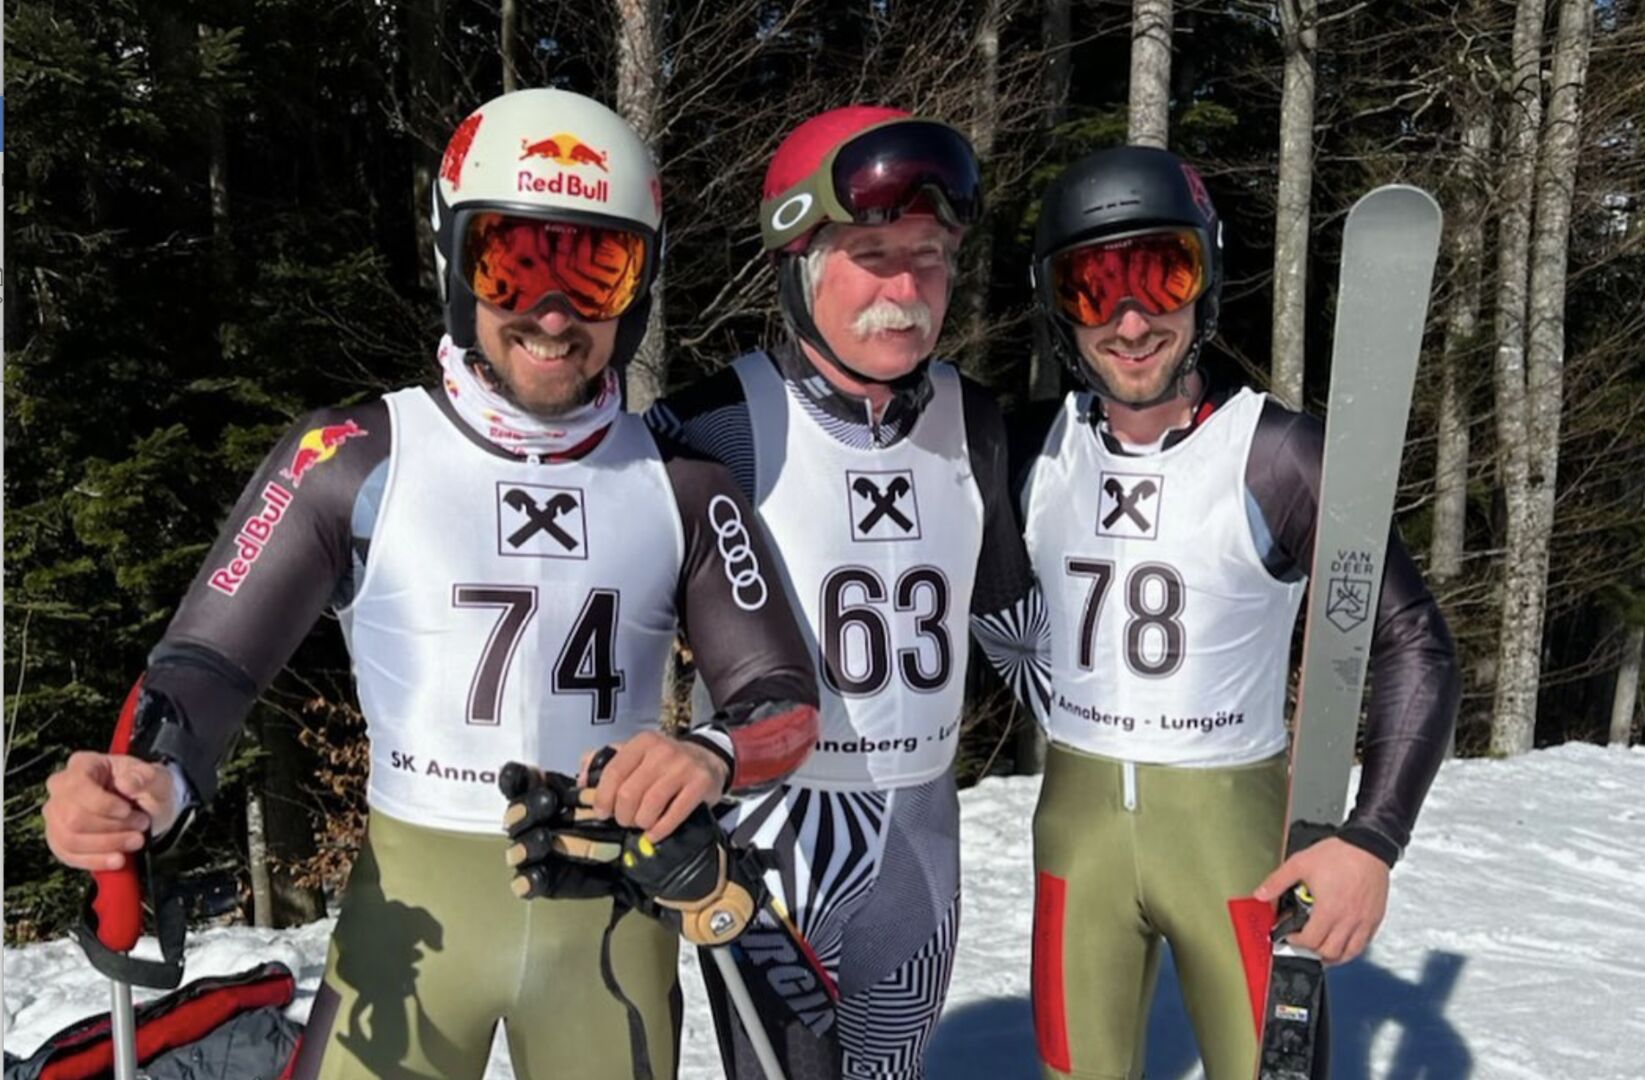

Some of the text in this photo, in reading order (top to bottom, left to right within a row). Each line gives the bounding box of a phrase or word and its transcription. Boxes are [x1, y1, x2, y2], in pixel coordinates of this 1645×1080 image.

[517, 171, 609, 203] Red Bull
[207, 481, 294, 596] Red Bull
[1337, 549, 1372, 562] VAN
[1330, 561, 1374, 575] DEER
[818, 564, 954, 699] 63
[1064, 556, 1187, 680] 78
[452, 583, 626, 726] 74
[1058, 695, 1136, 732] Annaberg
[1160, 711, 1246, 733] Lungötz
[391, 750, 418, 773] SK
